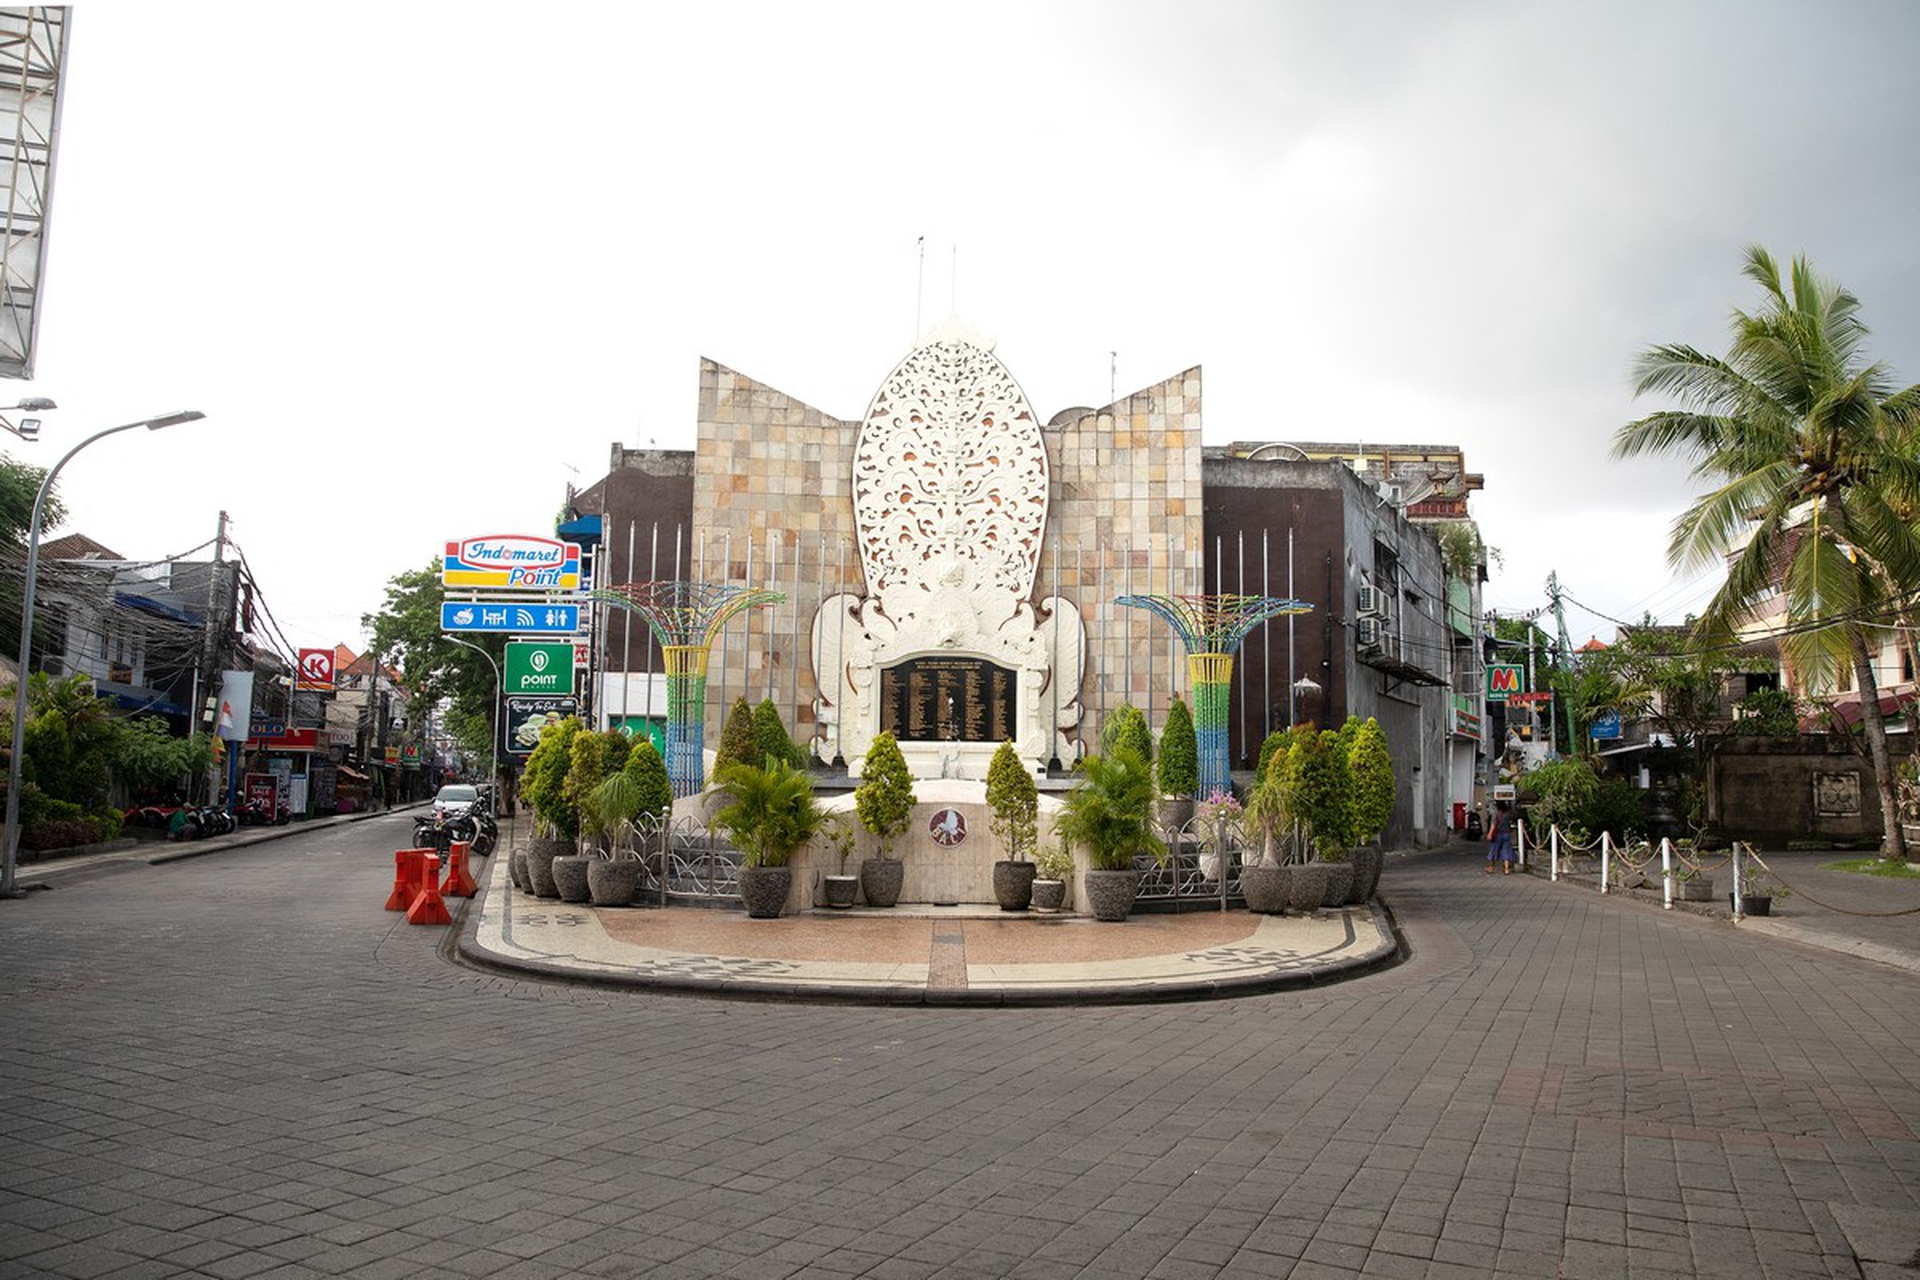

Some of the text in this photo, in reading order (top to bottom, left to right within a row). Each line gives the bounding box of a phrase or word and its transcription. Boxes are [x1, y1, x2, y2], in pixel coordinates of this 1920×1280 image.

[468, 543, 559, 562] Indomaret
[509, 568, 561, 585] Point
[310, 658, 326, 676] K
